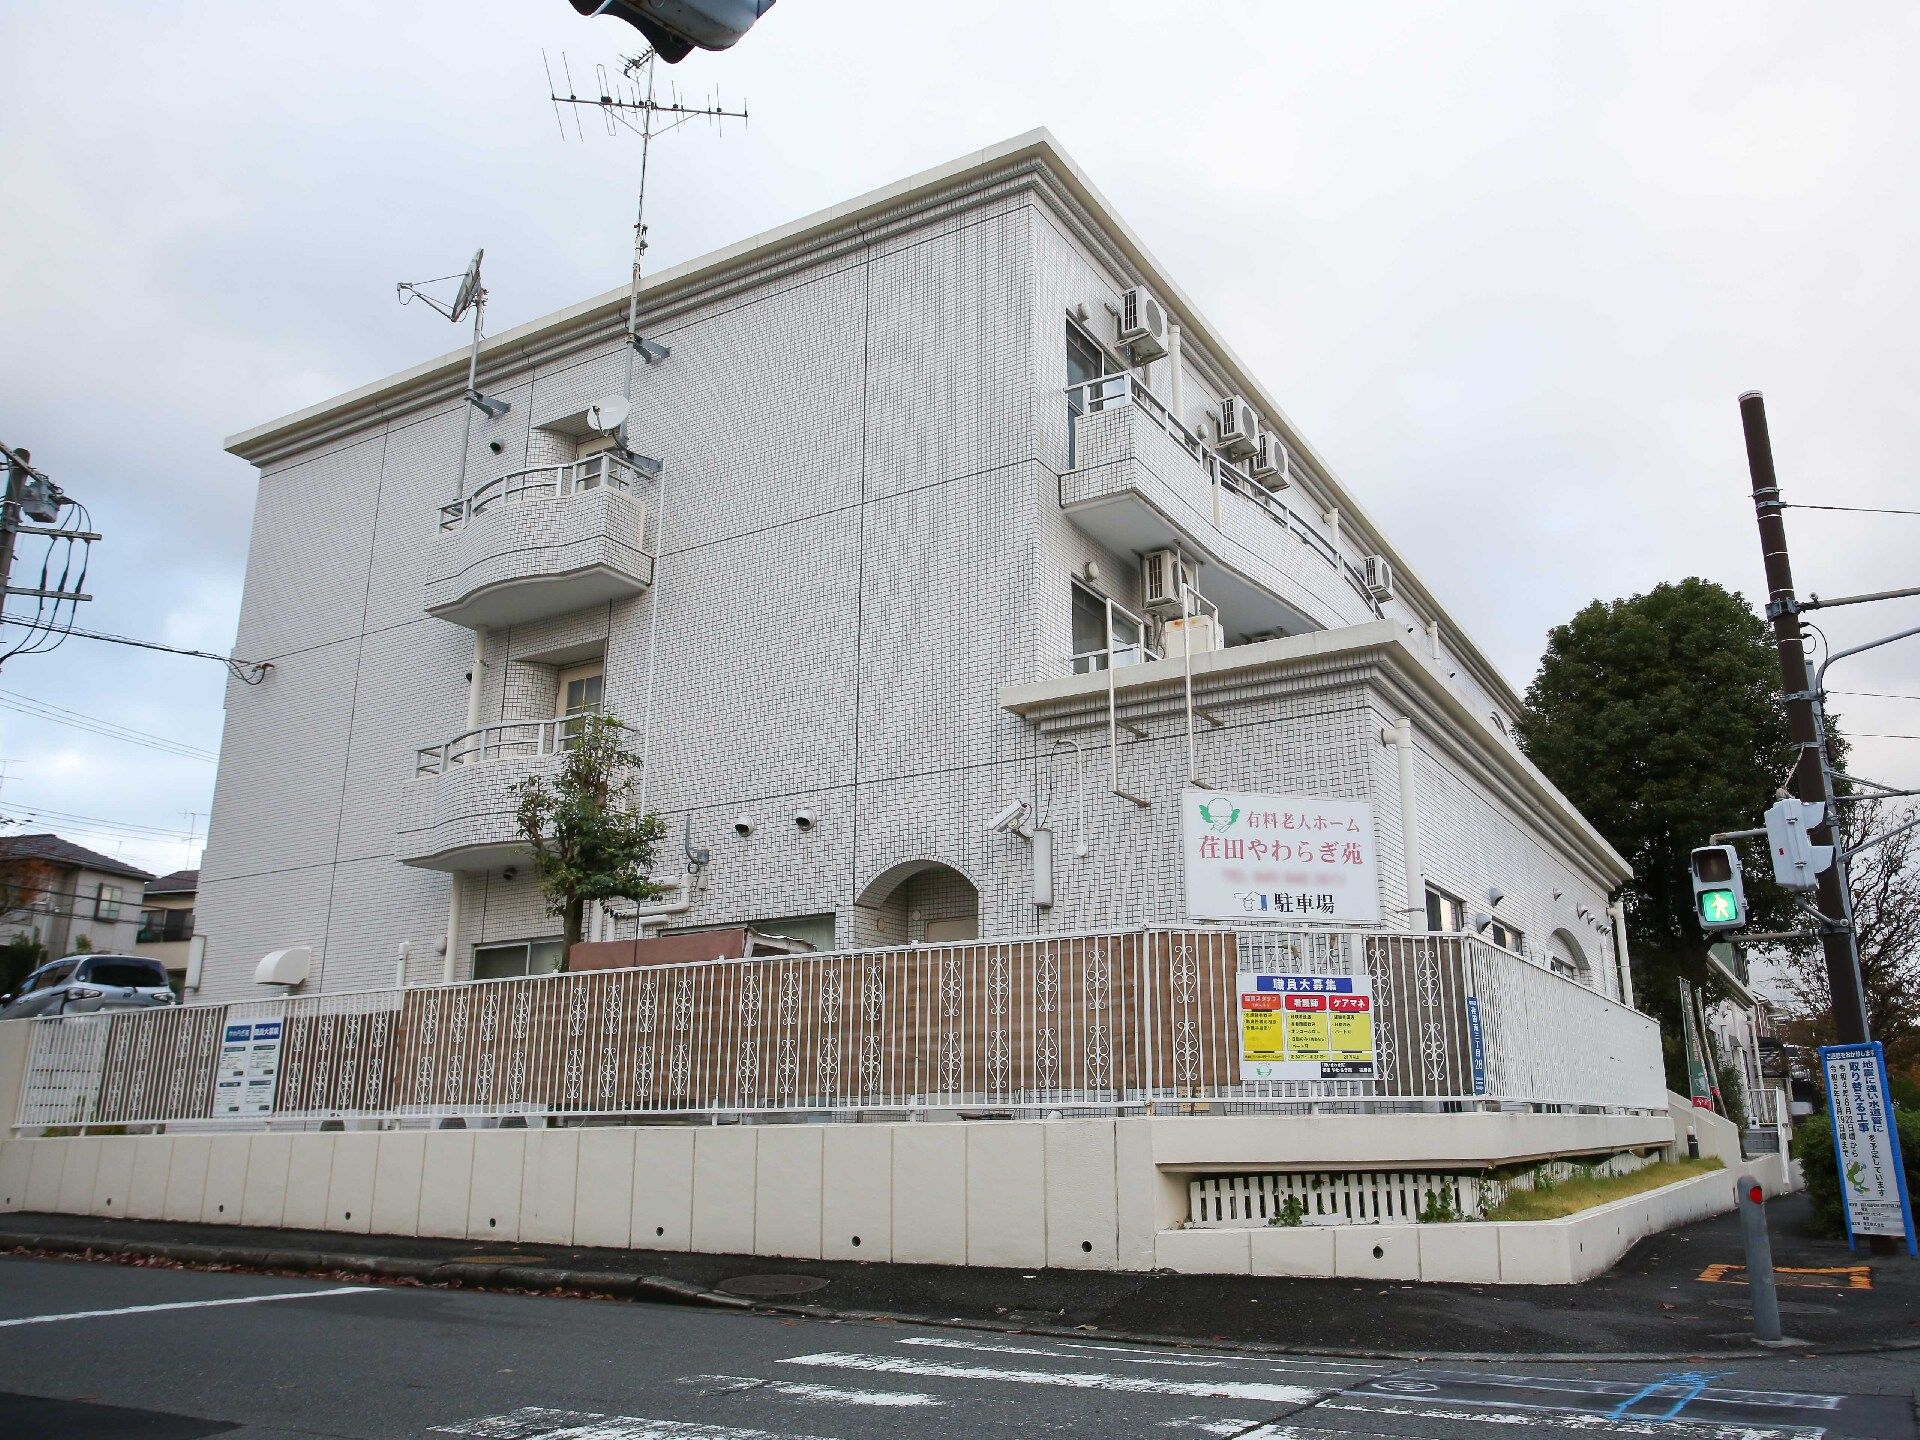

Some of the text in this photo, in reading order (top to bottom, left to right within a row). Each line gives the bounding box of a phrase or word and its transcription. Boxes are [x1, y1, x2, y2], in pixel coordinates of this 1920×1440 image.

[1246, 811, 1360, 833] 有料老人ホーム
[1198, 835, 1365, 865] 荏田やわらぎ苑
[1273, 892, 1335, 914] 駐車場
[1272, 978, 1337, 991] 職員大募集
[1293, 997, 1319, 1008] 看護師
[1332, 998, 1366, 1008] ケアマネ
[1474, 1059, 1483, 1070] 28
[1848, 1062, 1870, 1133] 取り替える工事
[1862, 1060, 1885, 1133] 地震に強い水道管に
[1868, 1135, 1885, 1197] を予定しています
